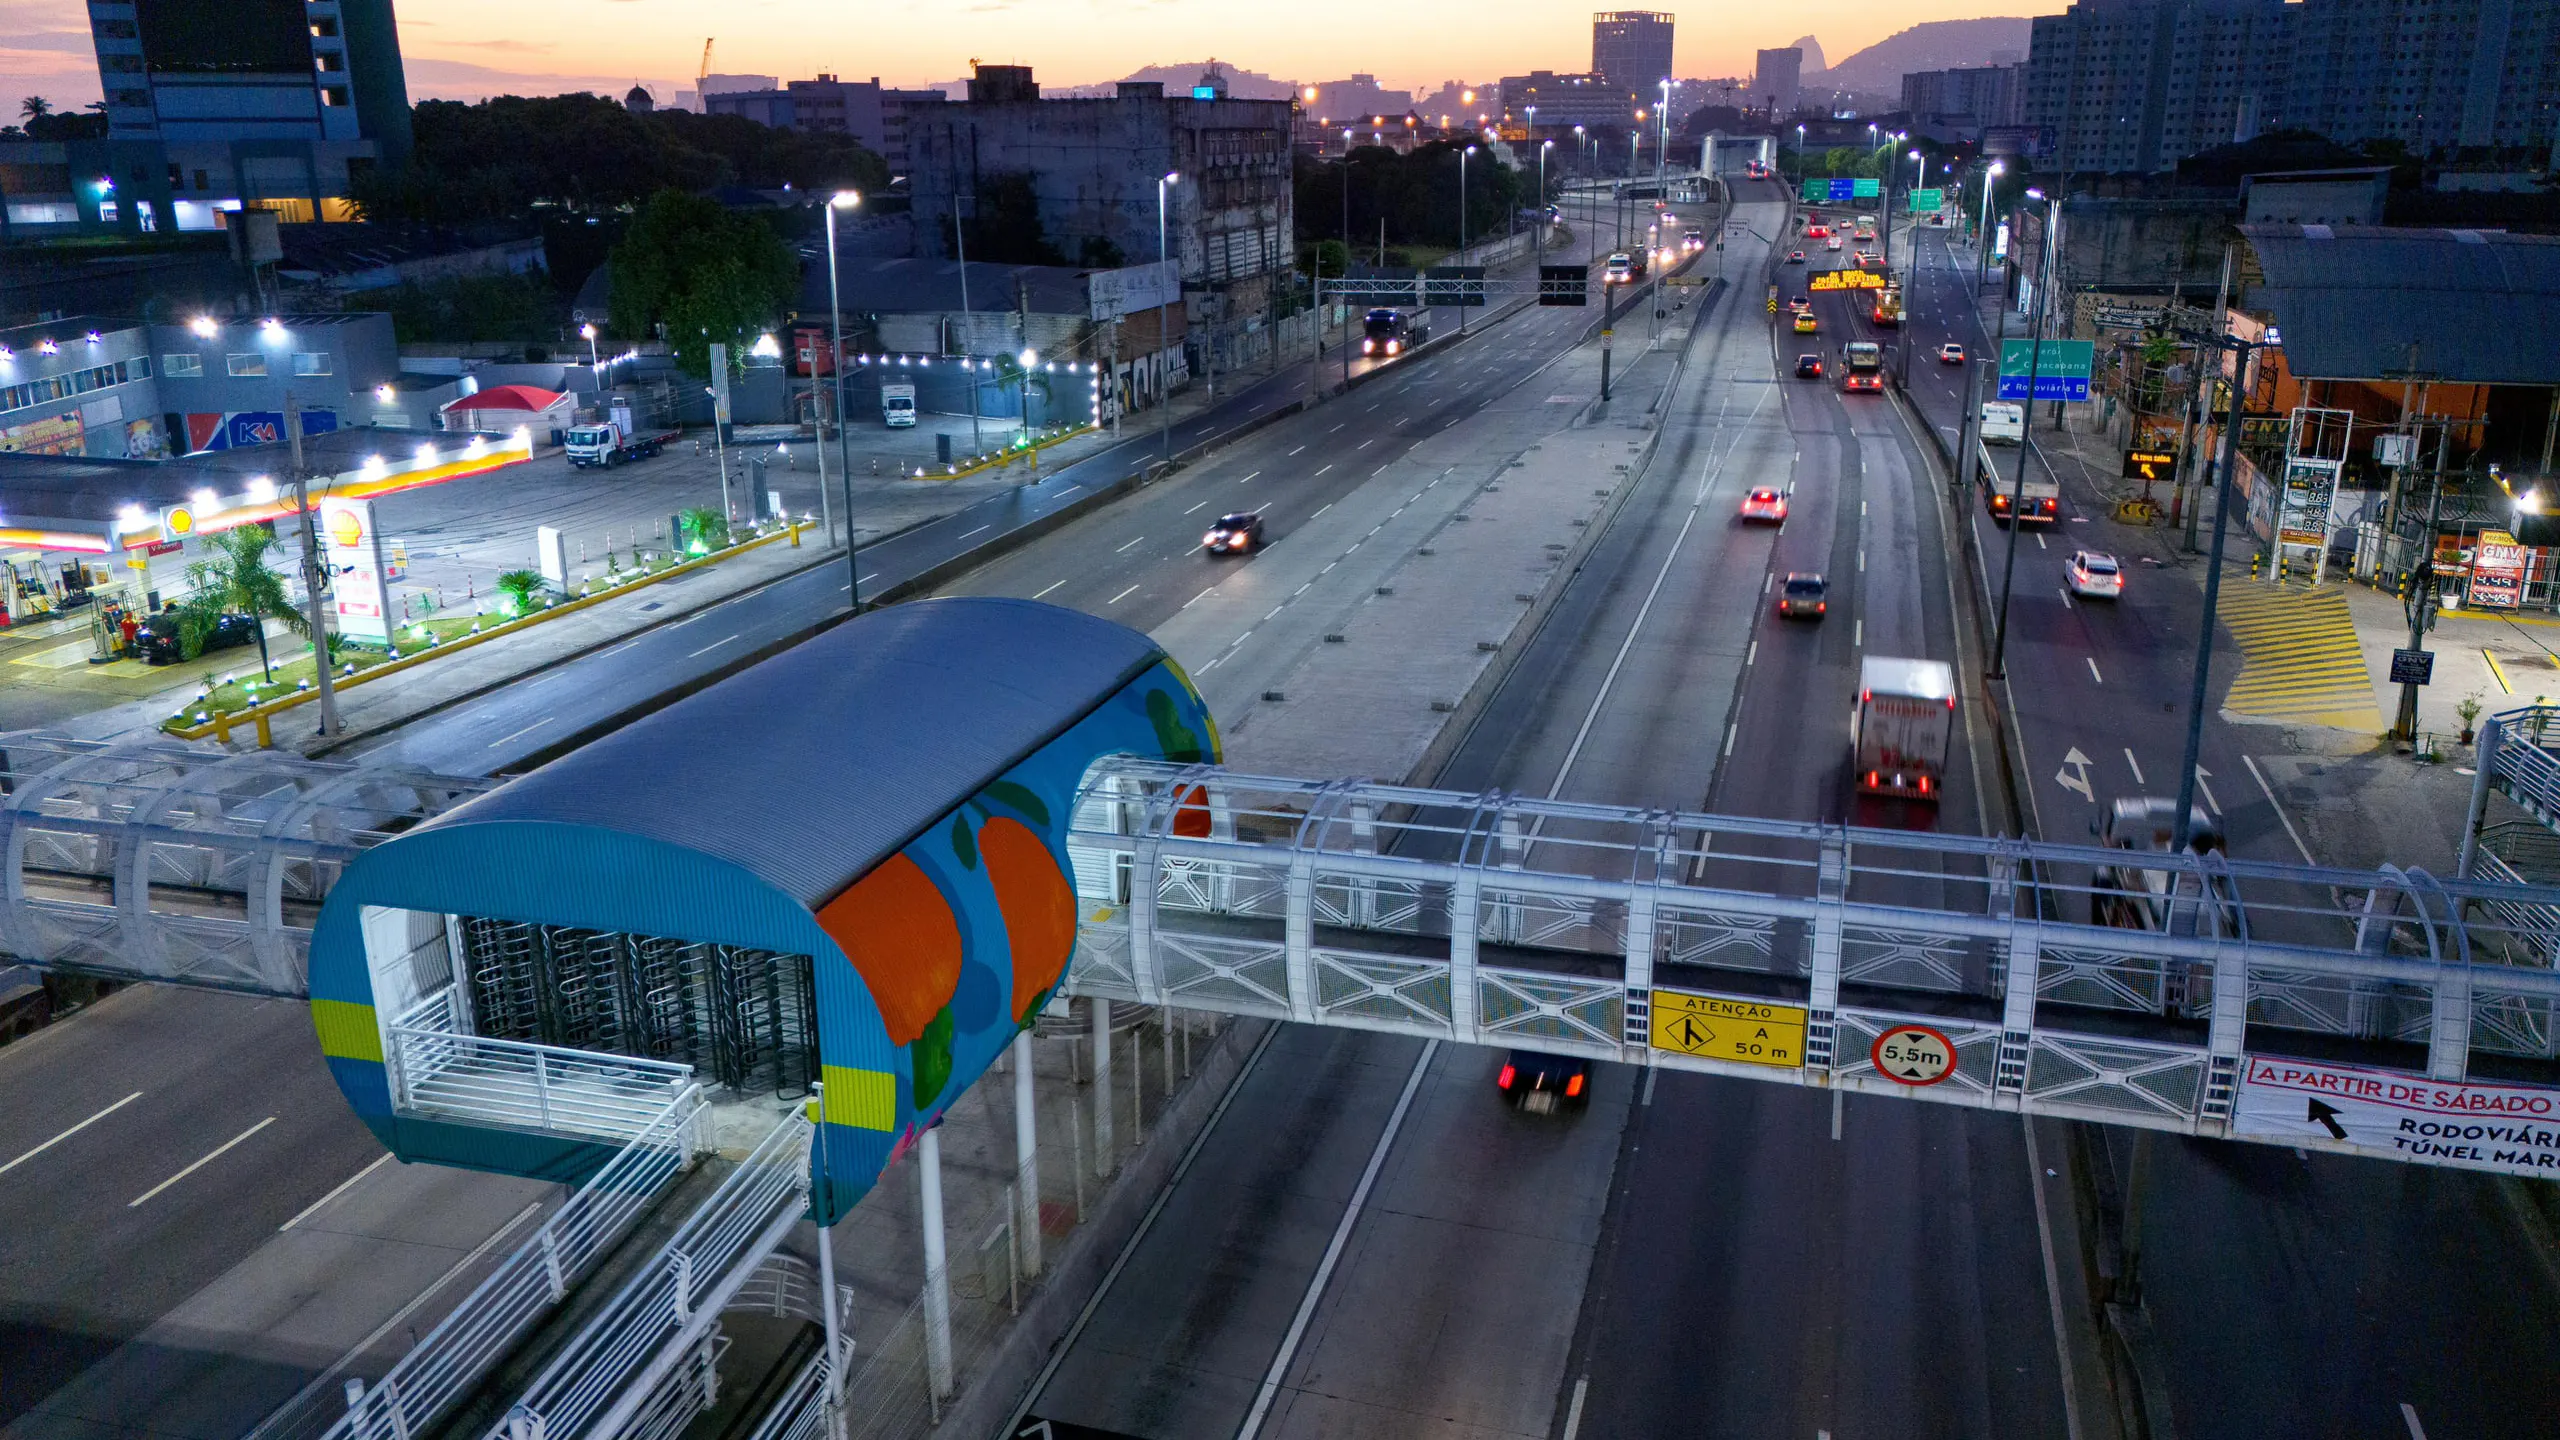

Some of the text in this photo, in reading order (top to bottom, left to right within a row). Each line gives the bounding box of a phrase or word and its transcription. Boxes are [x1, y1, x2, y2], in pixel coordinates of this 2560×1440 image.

[2025, 347, 2061, 355] Nerói
[2023, 361, 2086, 370] Cpacabana
[2016, 383, 2071, 392] Rooviária
[2243, 420, 2290, 433] GNV
[2482, 545, 2521, 560] GNV
[1685, 998, 1772, 1018] ATENÇÃO
[1754, 1027, 1769, 1039] A
[1735, 1042, 1787, 1058] 50 m
[1884, 1045, 1942, 1065] 5,5m
[2256, 1066, 2552, 1114] A PARTIR DE SÁBADO
[2393, 1136, 2484, 1161] TÚNEL
